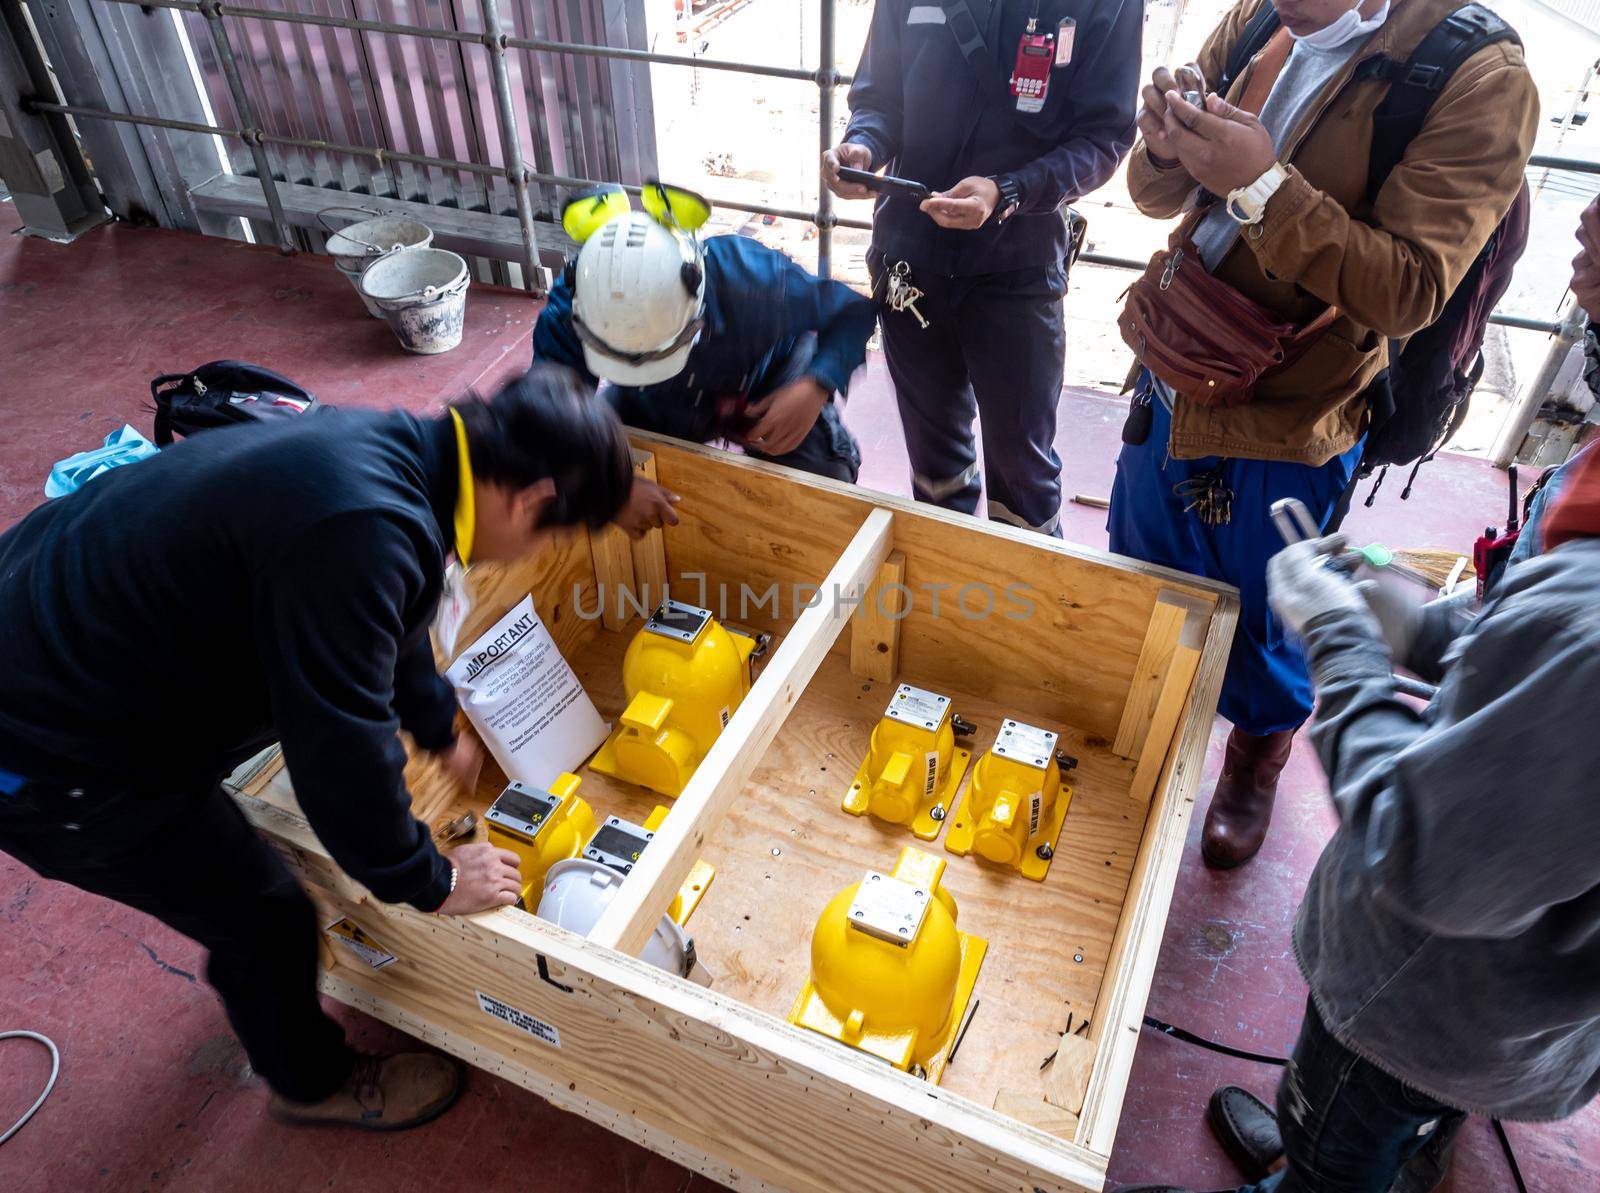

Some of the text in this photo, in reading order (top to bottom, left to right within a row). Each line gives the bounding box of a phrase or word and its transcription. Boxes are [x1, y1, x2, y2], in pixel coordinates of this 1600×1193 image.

[465, 612, 533, 676] IMPORTANT
[486, 677, 500, 688] THIS
[498, 657, 525, 680] ENVELOPE
[502, 657, 545, 694] OF THIS EQUIPMENT
[517, 665, 527, 674] ON
[525, 657, 535, 667] THE
[533, 649, 545, 661] SAFE
[494, 696, 519, 716] information
[508, 733, 523, 746] These
[522, 715, 546, 736] documents
[544, 705, 556, 717] must
[560, 687, 576, 703] available
[510, 733, 534, 753] inspection
